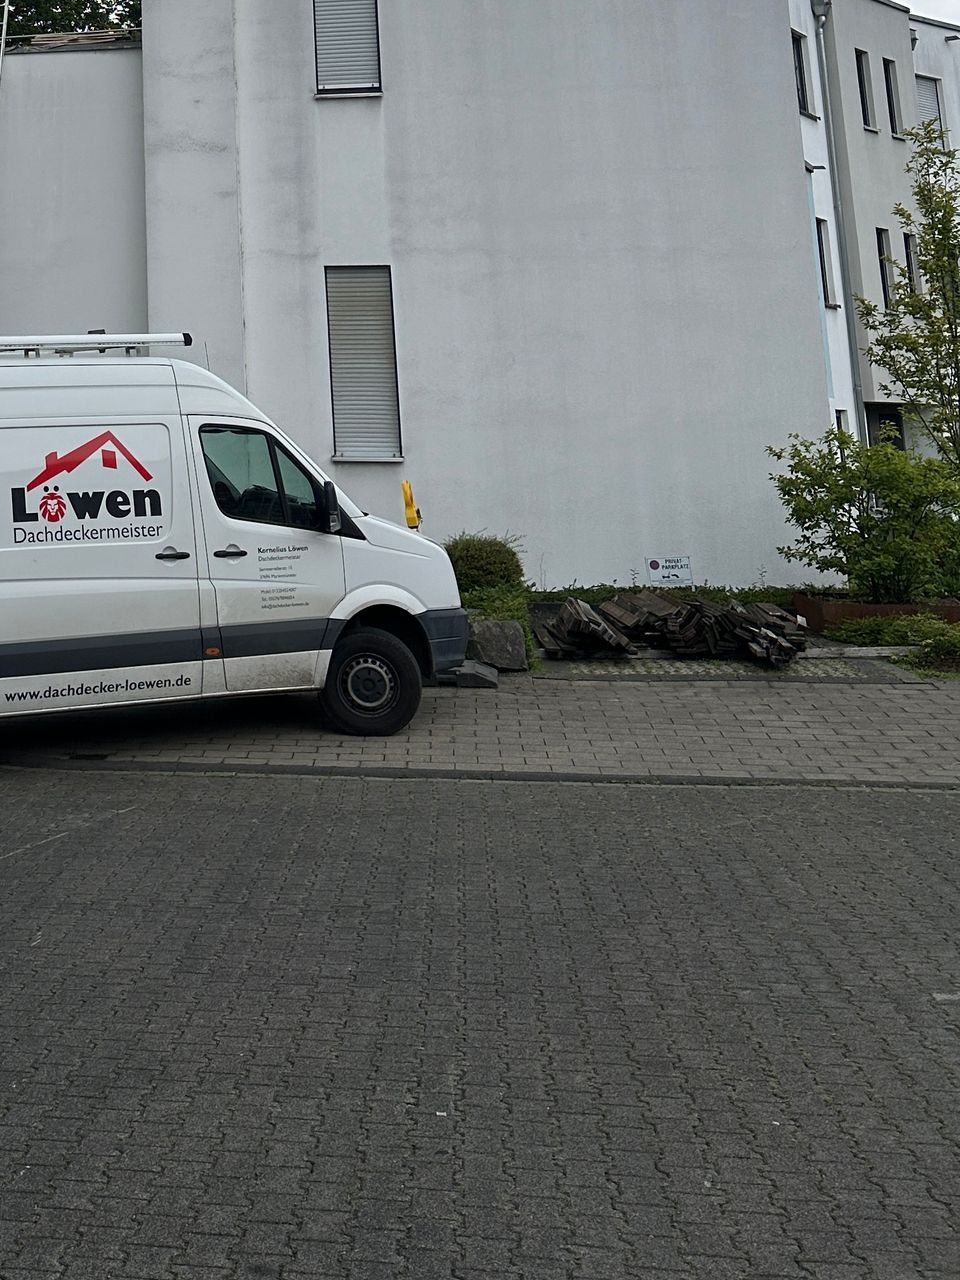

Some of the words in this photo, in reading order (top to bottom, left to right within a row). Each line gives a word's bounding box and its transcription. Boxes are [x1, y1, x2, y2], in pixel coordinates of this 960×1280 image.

[11, 485, 162, 523] Löwen
[13, 523, 163, 544] Dachdeckermeister
[5, 675, 192, 702] www.dachdecker-loewen.de
